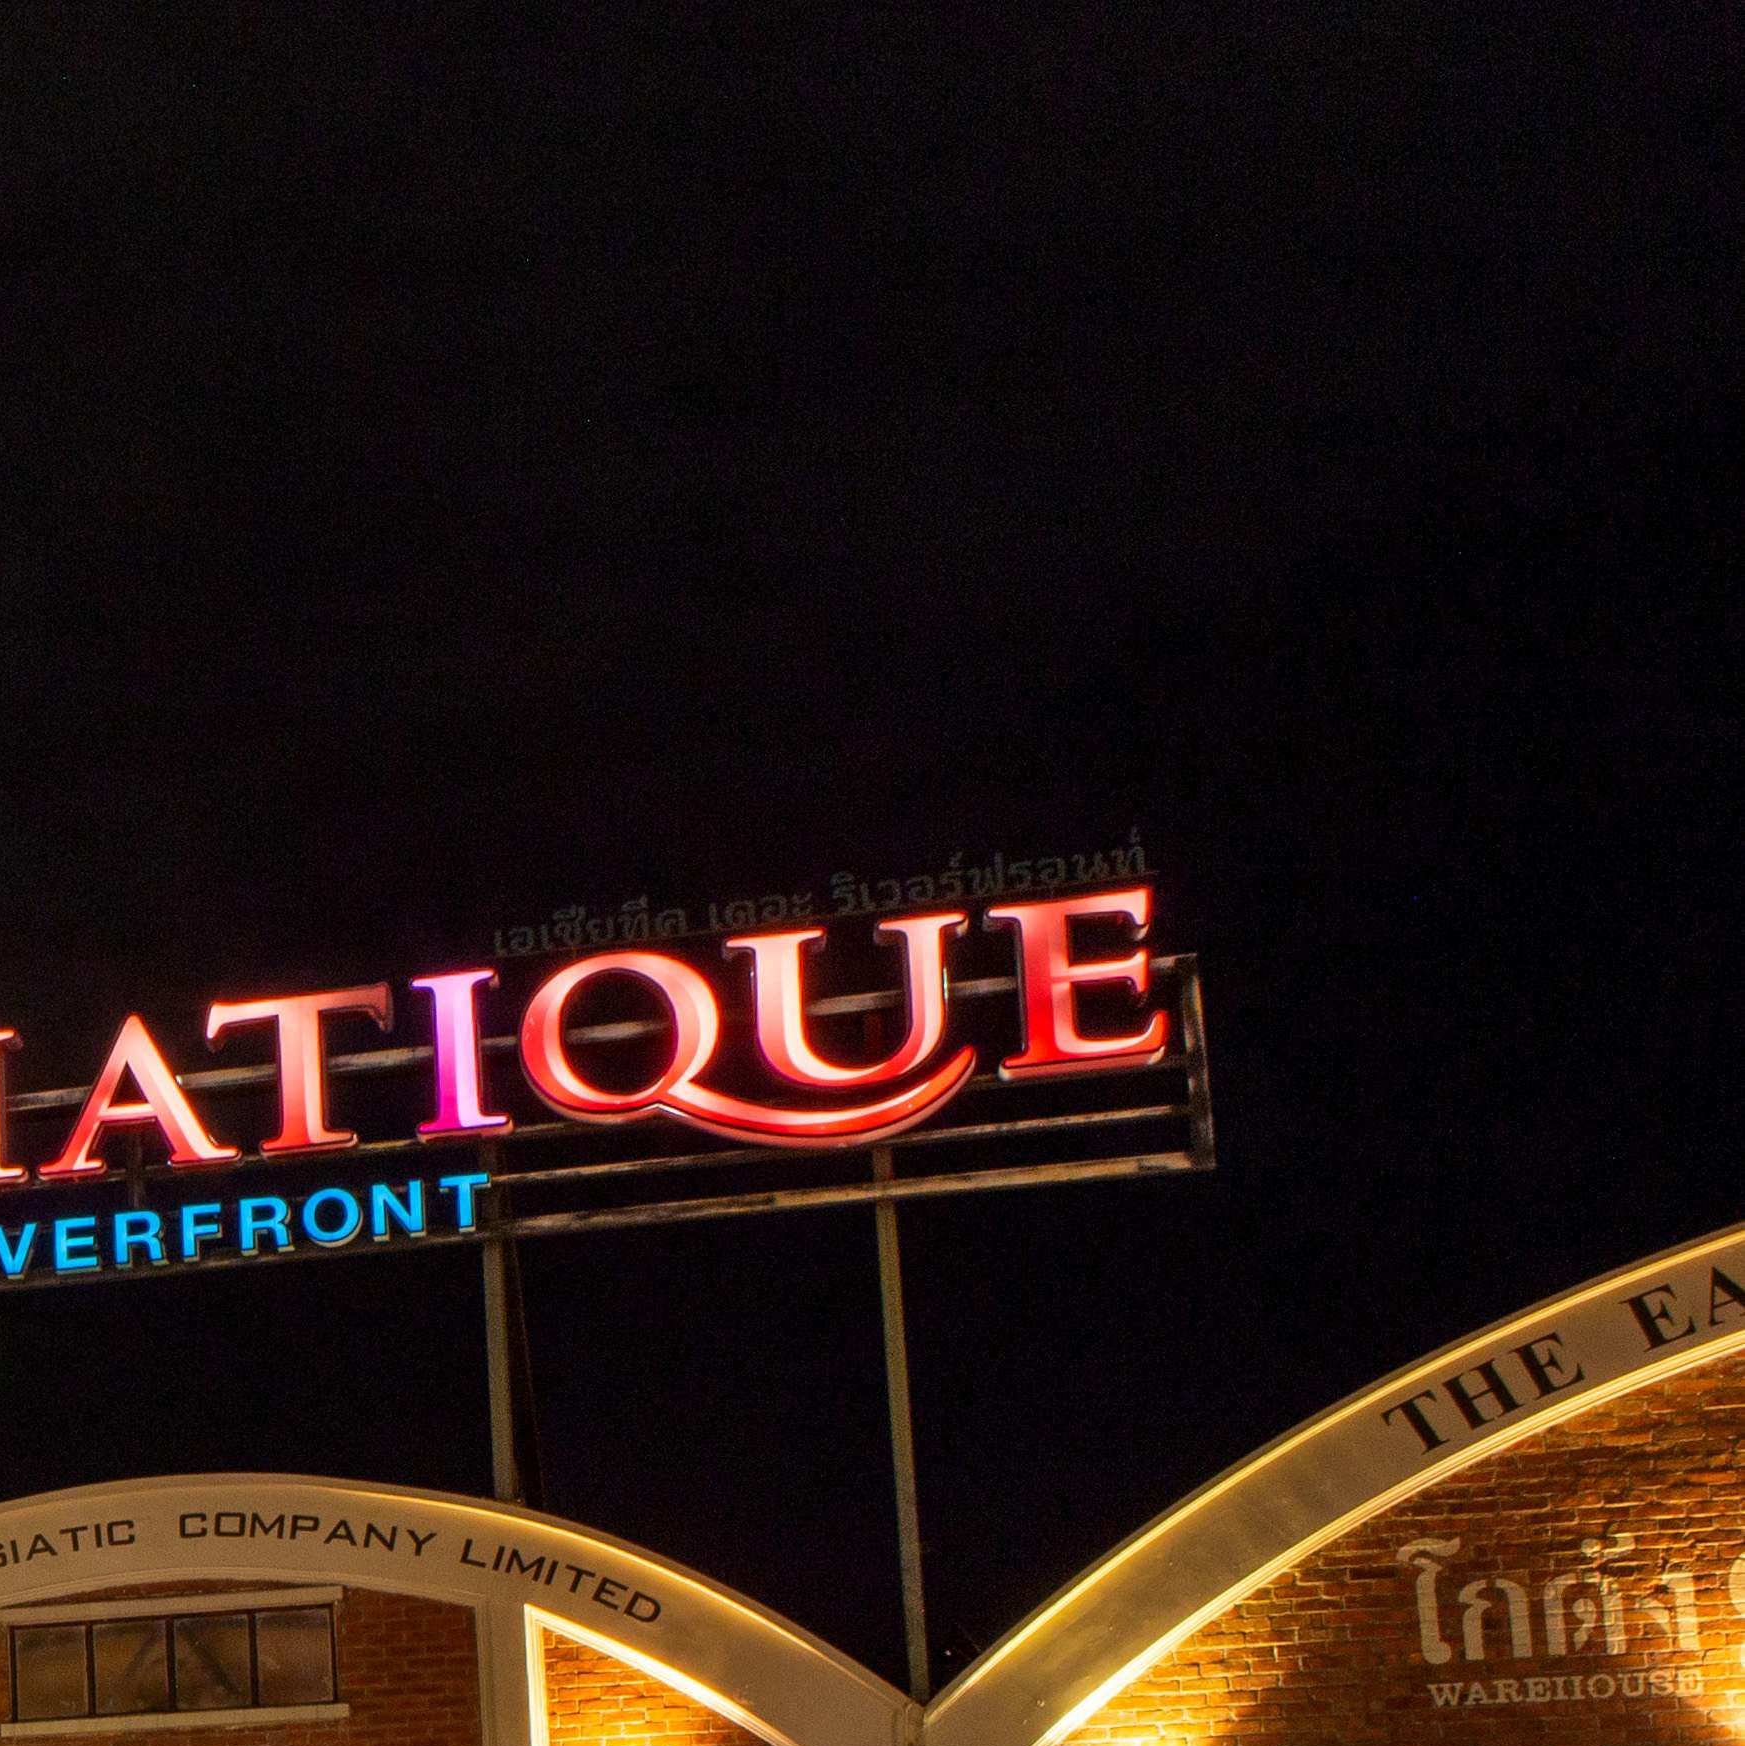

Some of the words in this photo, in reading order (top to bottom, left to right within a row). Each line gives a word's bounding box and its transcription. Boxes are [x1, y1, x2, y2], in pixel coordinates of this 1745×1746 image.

[1381, 1331, 1586, 1456] THE
[179, 1510, 437, 1558] COMPANY
[459, 1537, 663, 1624] LIMITED
[1395, 1532, 1702, 1667] โกดัง
[1426, 1668, 1707, 1709] WAREHOUSE
